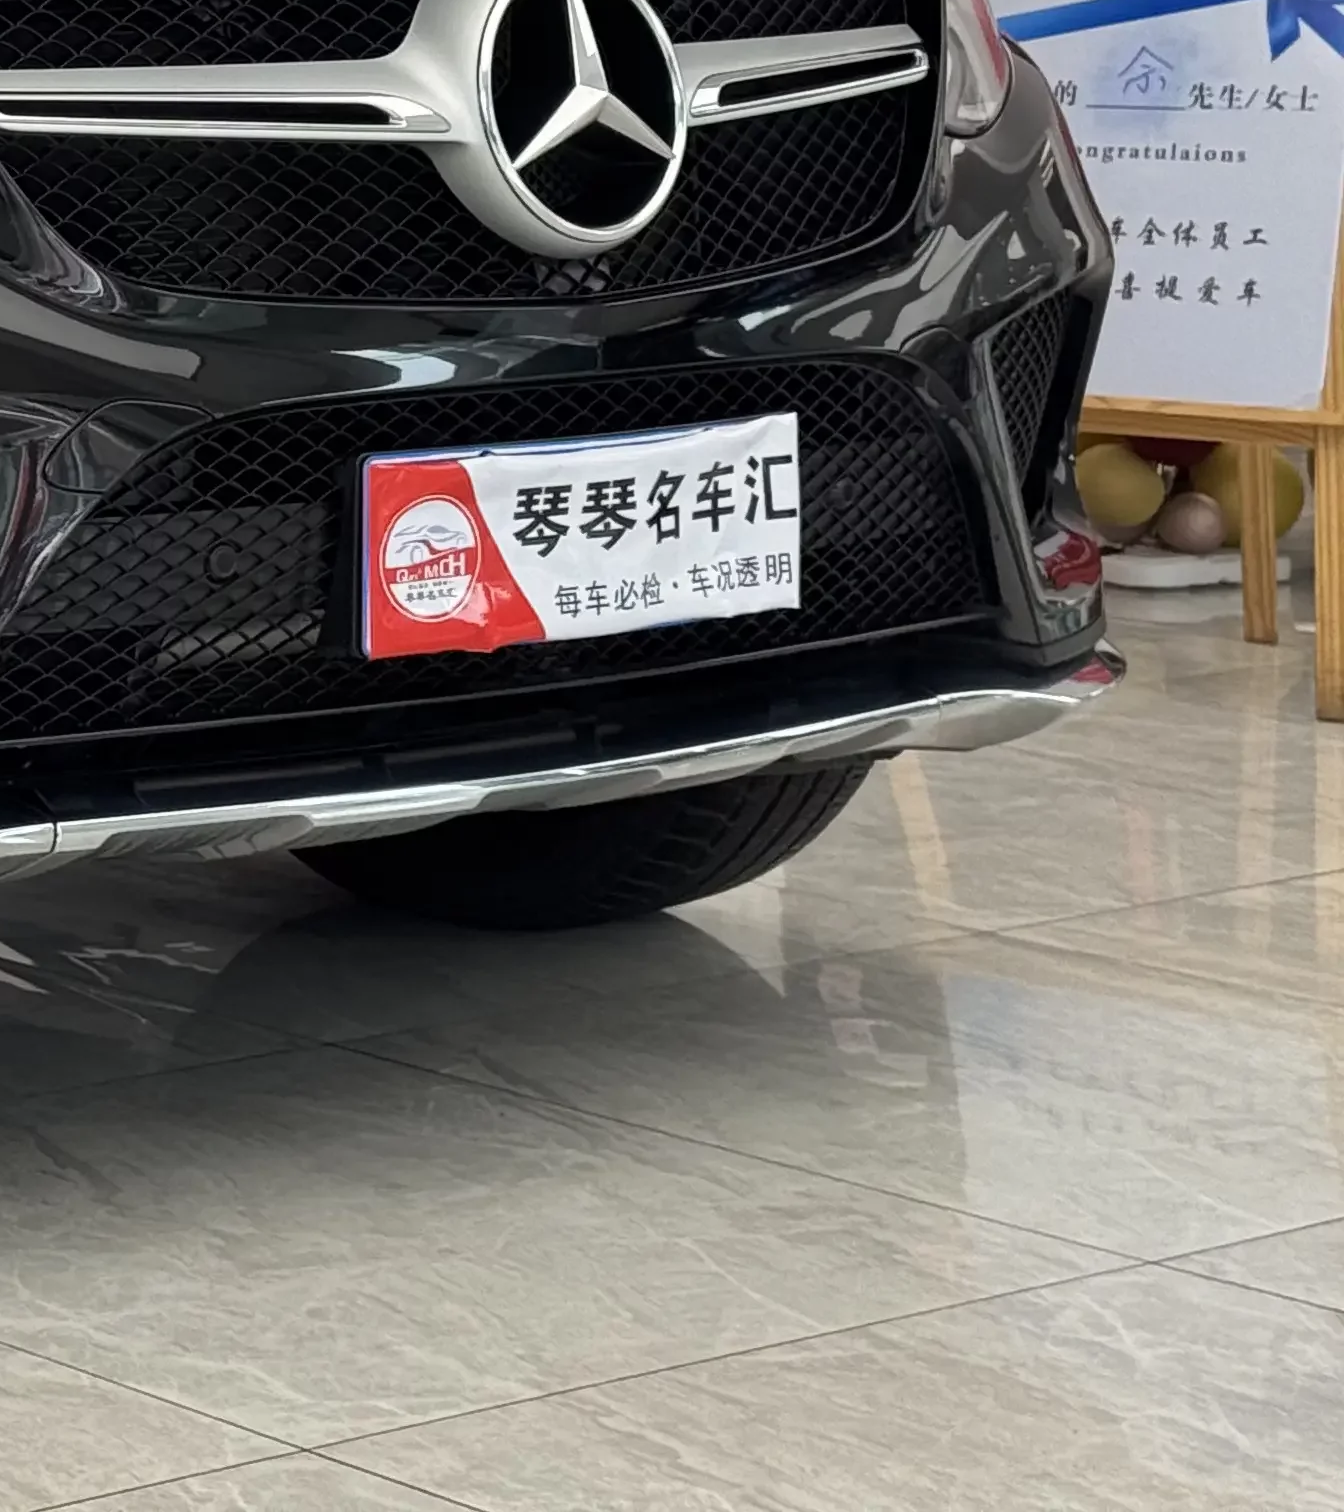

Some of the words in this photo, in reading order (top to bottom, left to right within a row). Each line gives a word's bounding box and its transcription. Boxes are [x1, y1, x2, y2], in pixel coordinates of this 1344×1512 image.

[1187, 81, 1319, 112] 先生/女士
[1078, 142, 1248, 165] ngratulaions
[1115, 270, 1262, 307] 喜提爱车
[512, 453, 798, 559] 琴琴名车汇
